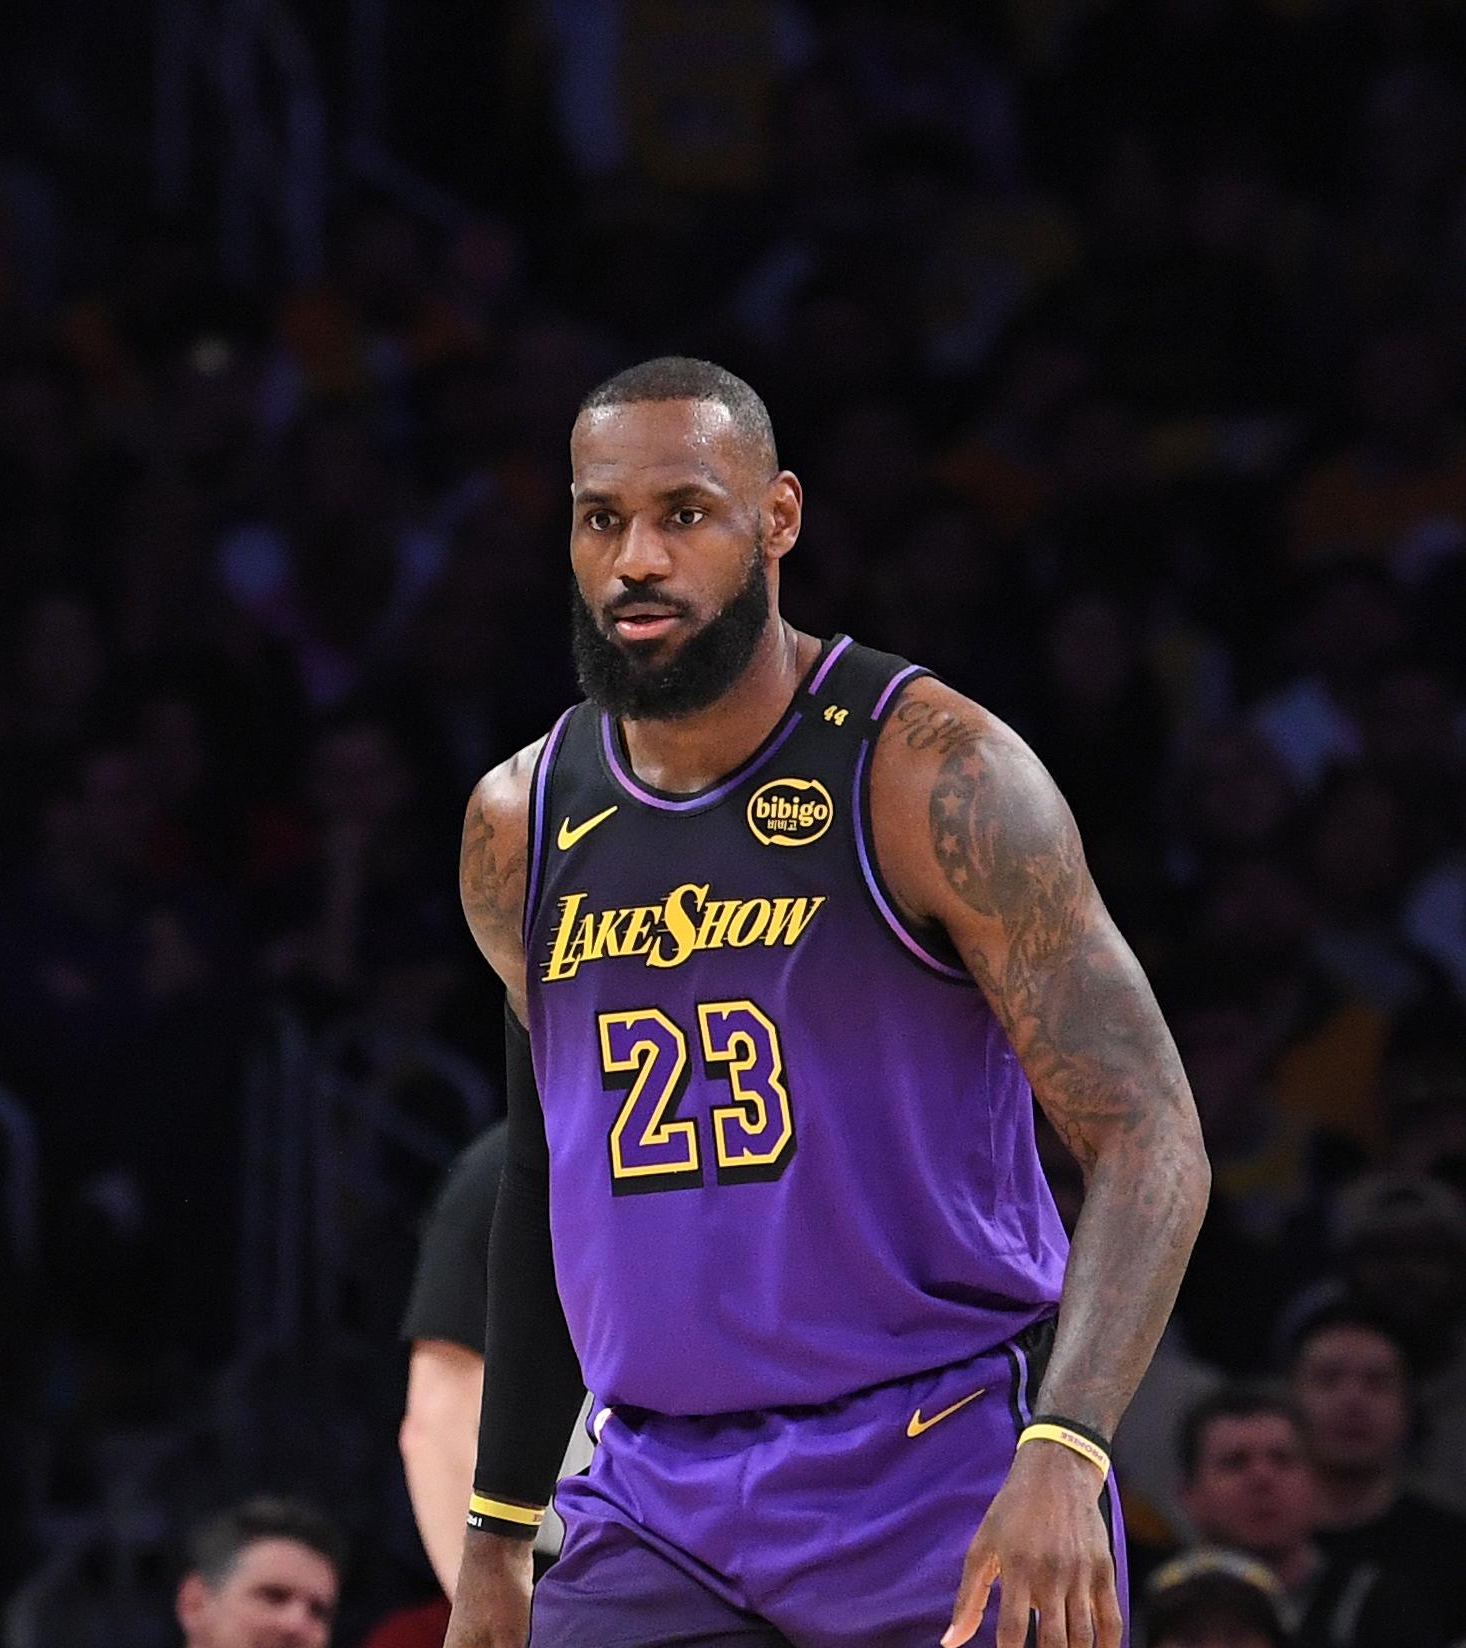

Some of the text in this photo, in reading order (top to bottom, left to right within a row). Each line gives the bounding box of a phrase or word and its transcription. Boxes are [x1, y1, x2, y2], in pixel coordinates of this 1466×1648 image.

[823, 704, 850, 727] 44
[756, 796, 828, 827] bibigo
[767, 819, 798, 831] 비비고
[597, 1000, 794, 1180] 23
